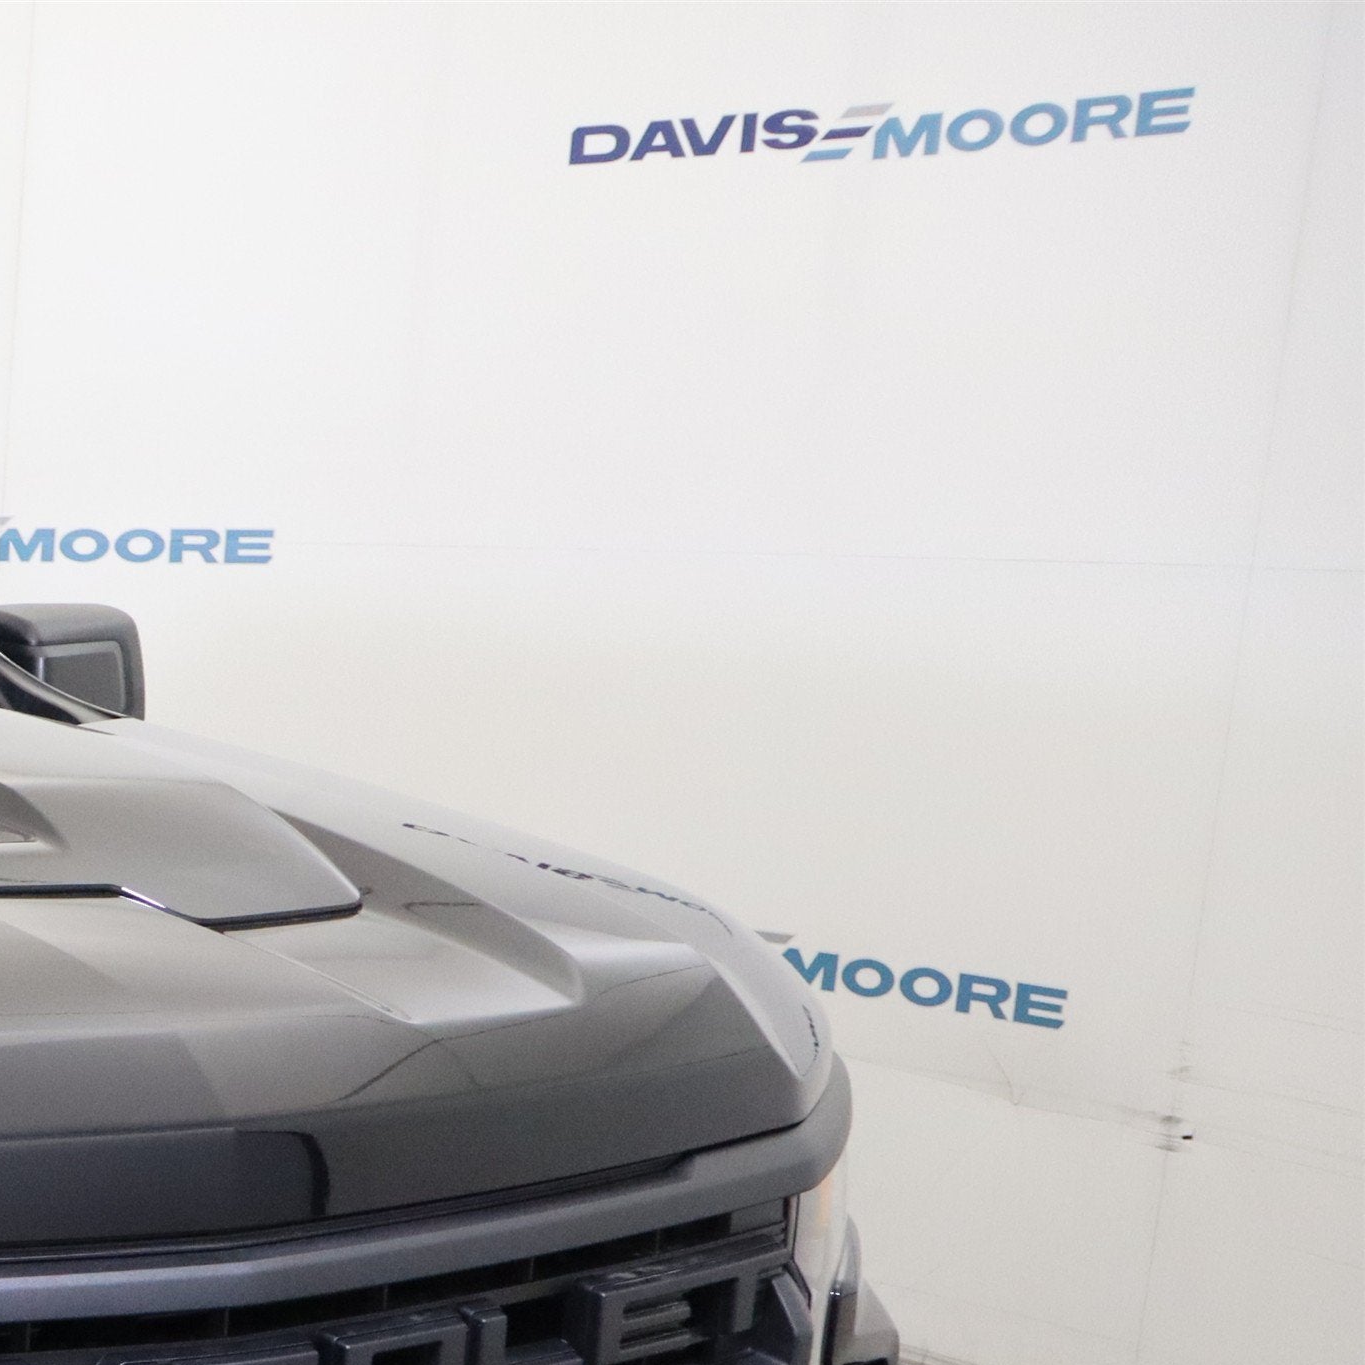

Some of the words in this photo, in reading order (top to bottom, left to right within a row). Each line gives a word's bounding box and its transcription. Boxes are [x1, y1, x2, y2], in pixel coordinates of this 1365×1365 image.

[569, 109, 816, 165] DAVIS
[871, 86, 1198, 160] MOORE
[782, 947, 1068, 1029] MOORE
